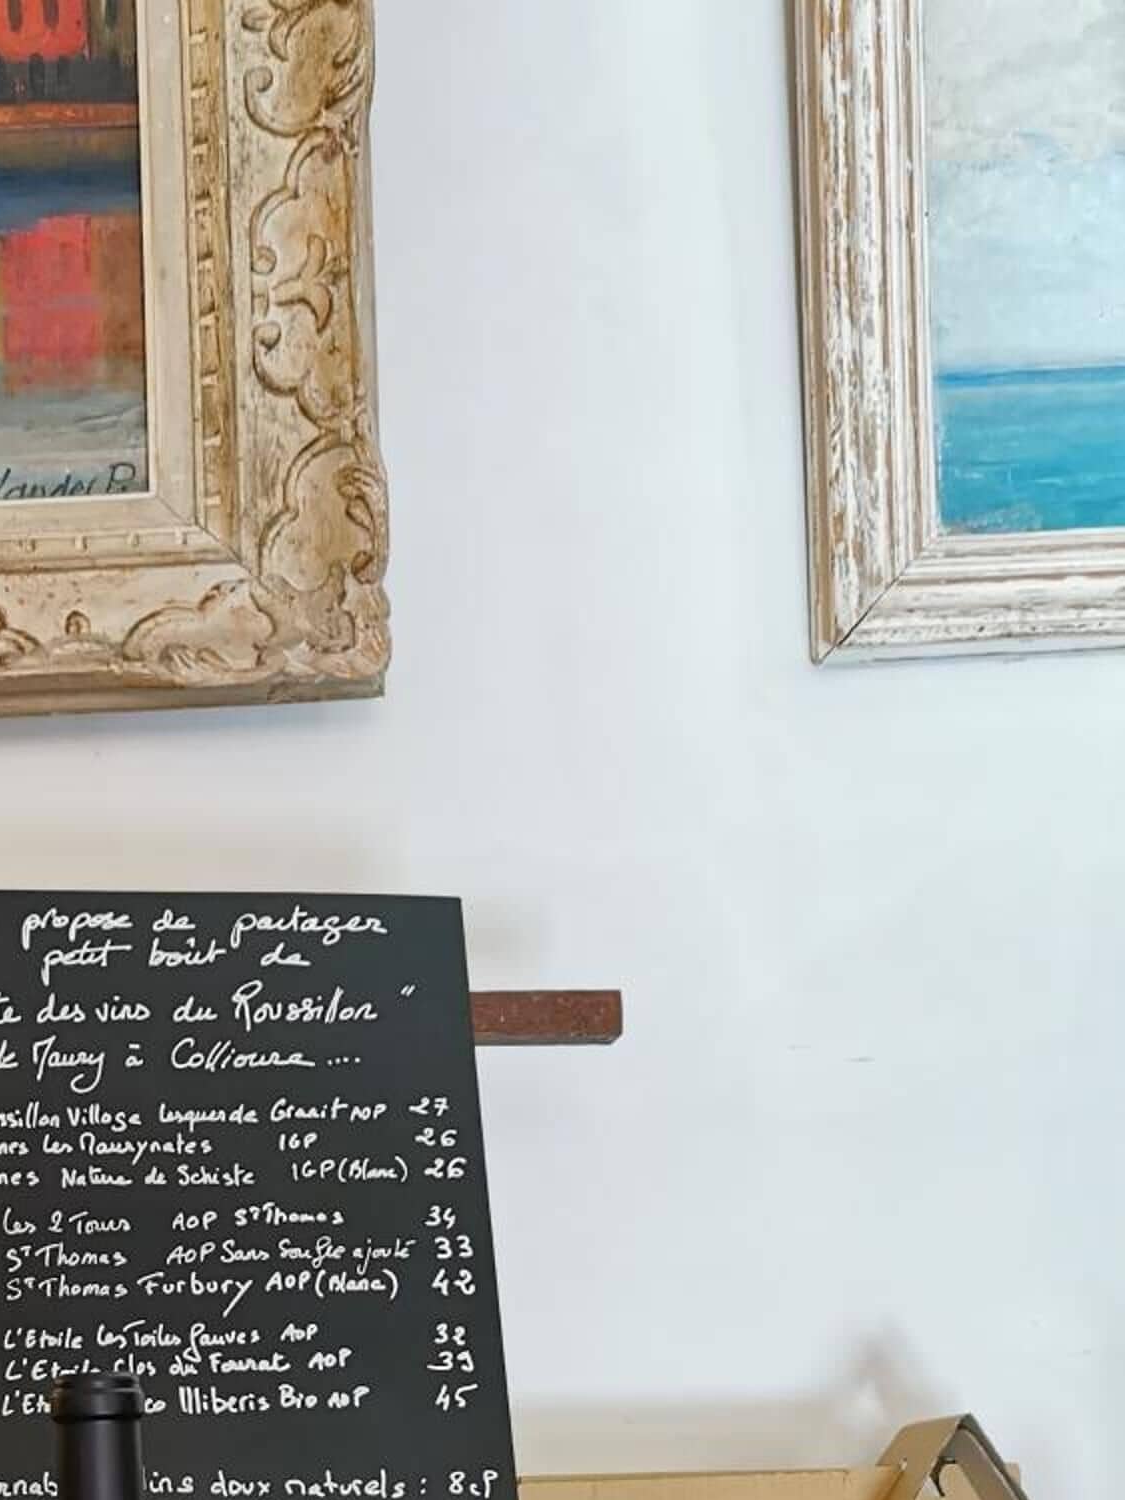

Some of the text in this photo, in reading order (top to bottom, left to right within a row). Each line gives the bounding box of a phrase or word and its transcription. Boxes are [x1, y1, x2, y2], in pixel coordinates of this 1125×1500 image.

[22, 907, 133, 950] propose
[152, 908, 196, 932] de
[230, 904, 388, 949] partager
[41, 939, 133, 987] petit
[260, 942, 311, 966] de
[36, 992, 86, 1023] des
[95, 996, 151, 1022] vins
[173, 996, 218, 1022] du
[67, 1103, 142, 1132] Village
[351, 1103, 387, 1122] AOP
[409, 1097, 449, 1117] 27
[279, 1133, 318, 1151] IGP
[415, 1128, 457, 1148] 26
[61, 1166, 133, 1189] Nature
[145, 1166, 167, 1186] de
[178, 1163, 256, 1186] Schiste
[291, 1160, 335, 1182] IGP
[424, 1157, 467, 1179] 26
[49, 1211, 64, 1233] 2
[68, 1211, 131, 1234] Tours
[425, 1206, 456, 1229] 34
[35, 1243, 127, 1268] Thomas
[220, 1239, 269, 1264] Sans
[434, 1235, 474, 1259] 33
[38, 1274, 128, 1298] Thomas
[137, 1272, 253, 1318] Furbury
[265, 1271, 311, 1293] AOP
[431, 1269, 476, 1296] 42
[280, 1323, 319, 1342] AOP
[434, 1323, 466, 1346] 32
[169, 1356, 198, 1375] du
[427, 1351, 475, 1372] 39
[279, 1384, 317, 1409] Bio
[435, 1384, 478, 1411] 45
[149, 1469, 405, 1498] ins doux naturels
